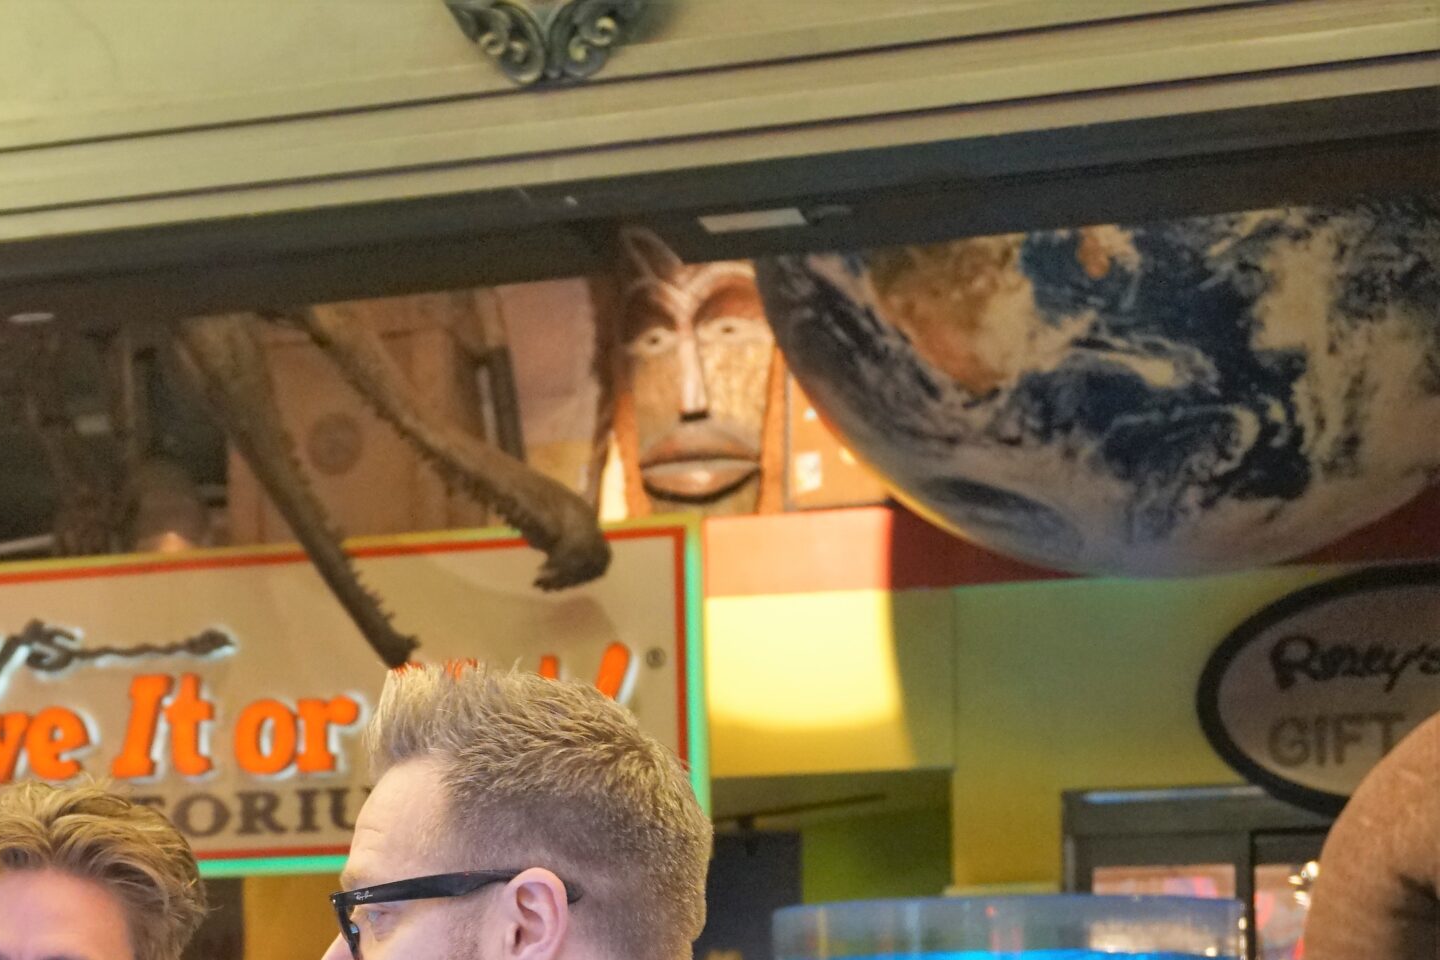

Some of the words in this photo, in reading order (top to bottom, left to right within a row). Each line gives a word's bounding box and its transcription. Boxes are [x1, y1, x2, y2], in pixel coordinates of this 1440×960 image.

[112, 674, 215, 778] It
[234, 692, 361, 776] or
[1268, 711, 1406, 768] GIFT
